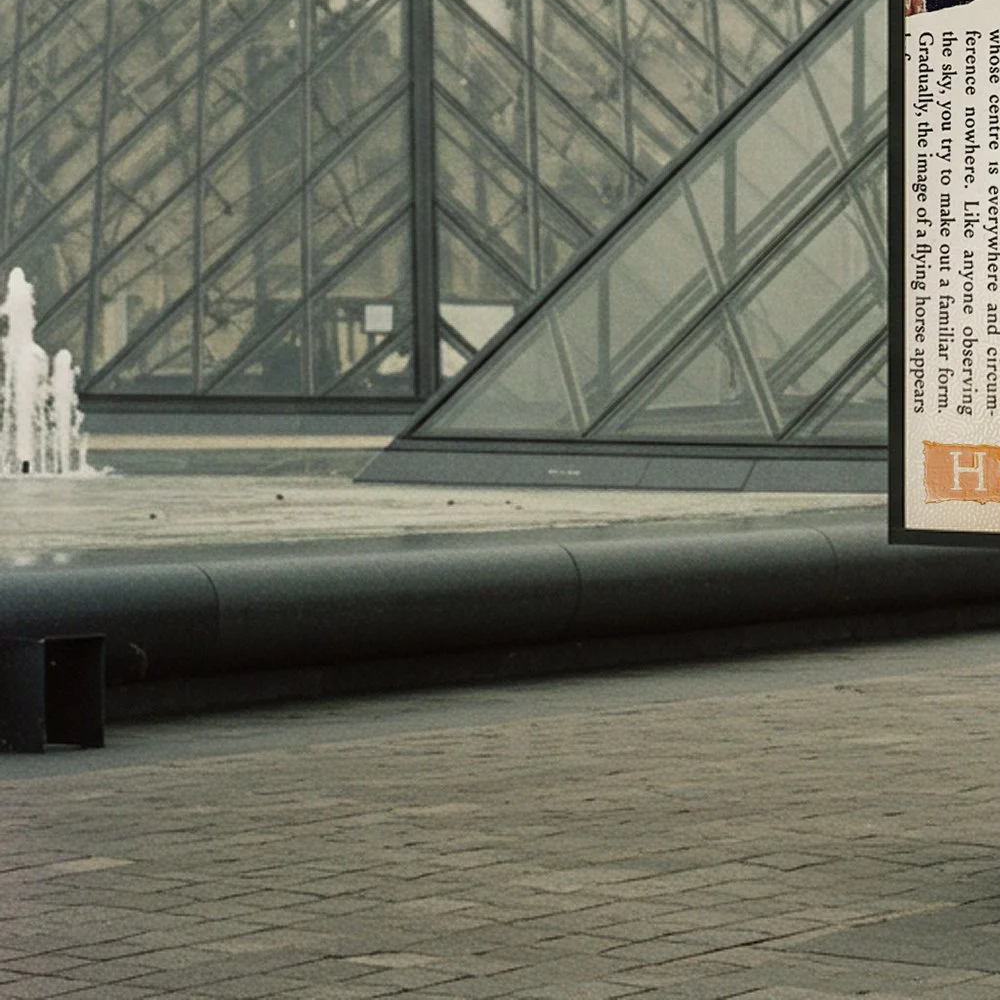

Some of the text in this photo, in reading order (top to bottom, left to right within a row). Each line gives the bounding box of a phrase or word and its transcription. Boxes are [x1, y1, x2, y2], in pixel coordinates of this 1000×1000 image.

[909, 32, 934, 413] Gradually, the image of a flying horse appears
[935, 31, 958, 413] the sky, you try to make out a familiar form.
[956, 30, 982, 416] ference nowhere. Like anyone observing
[988, 94, 1000, 150] centre
[949, 451, 988, 492] H
